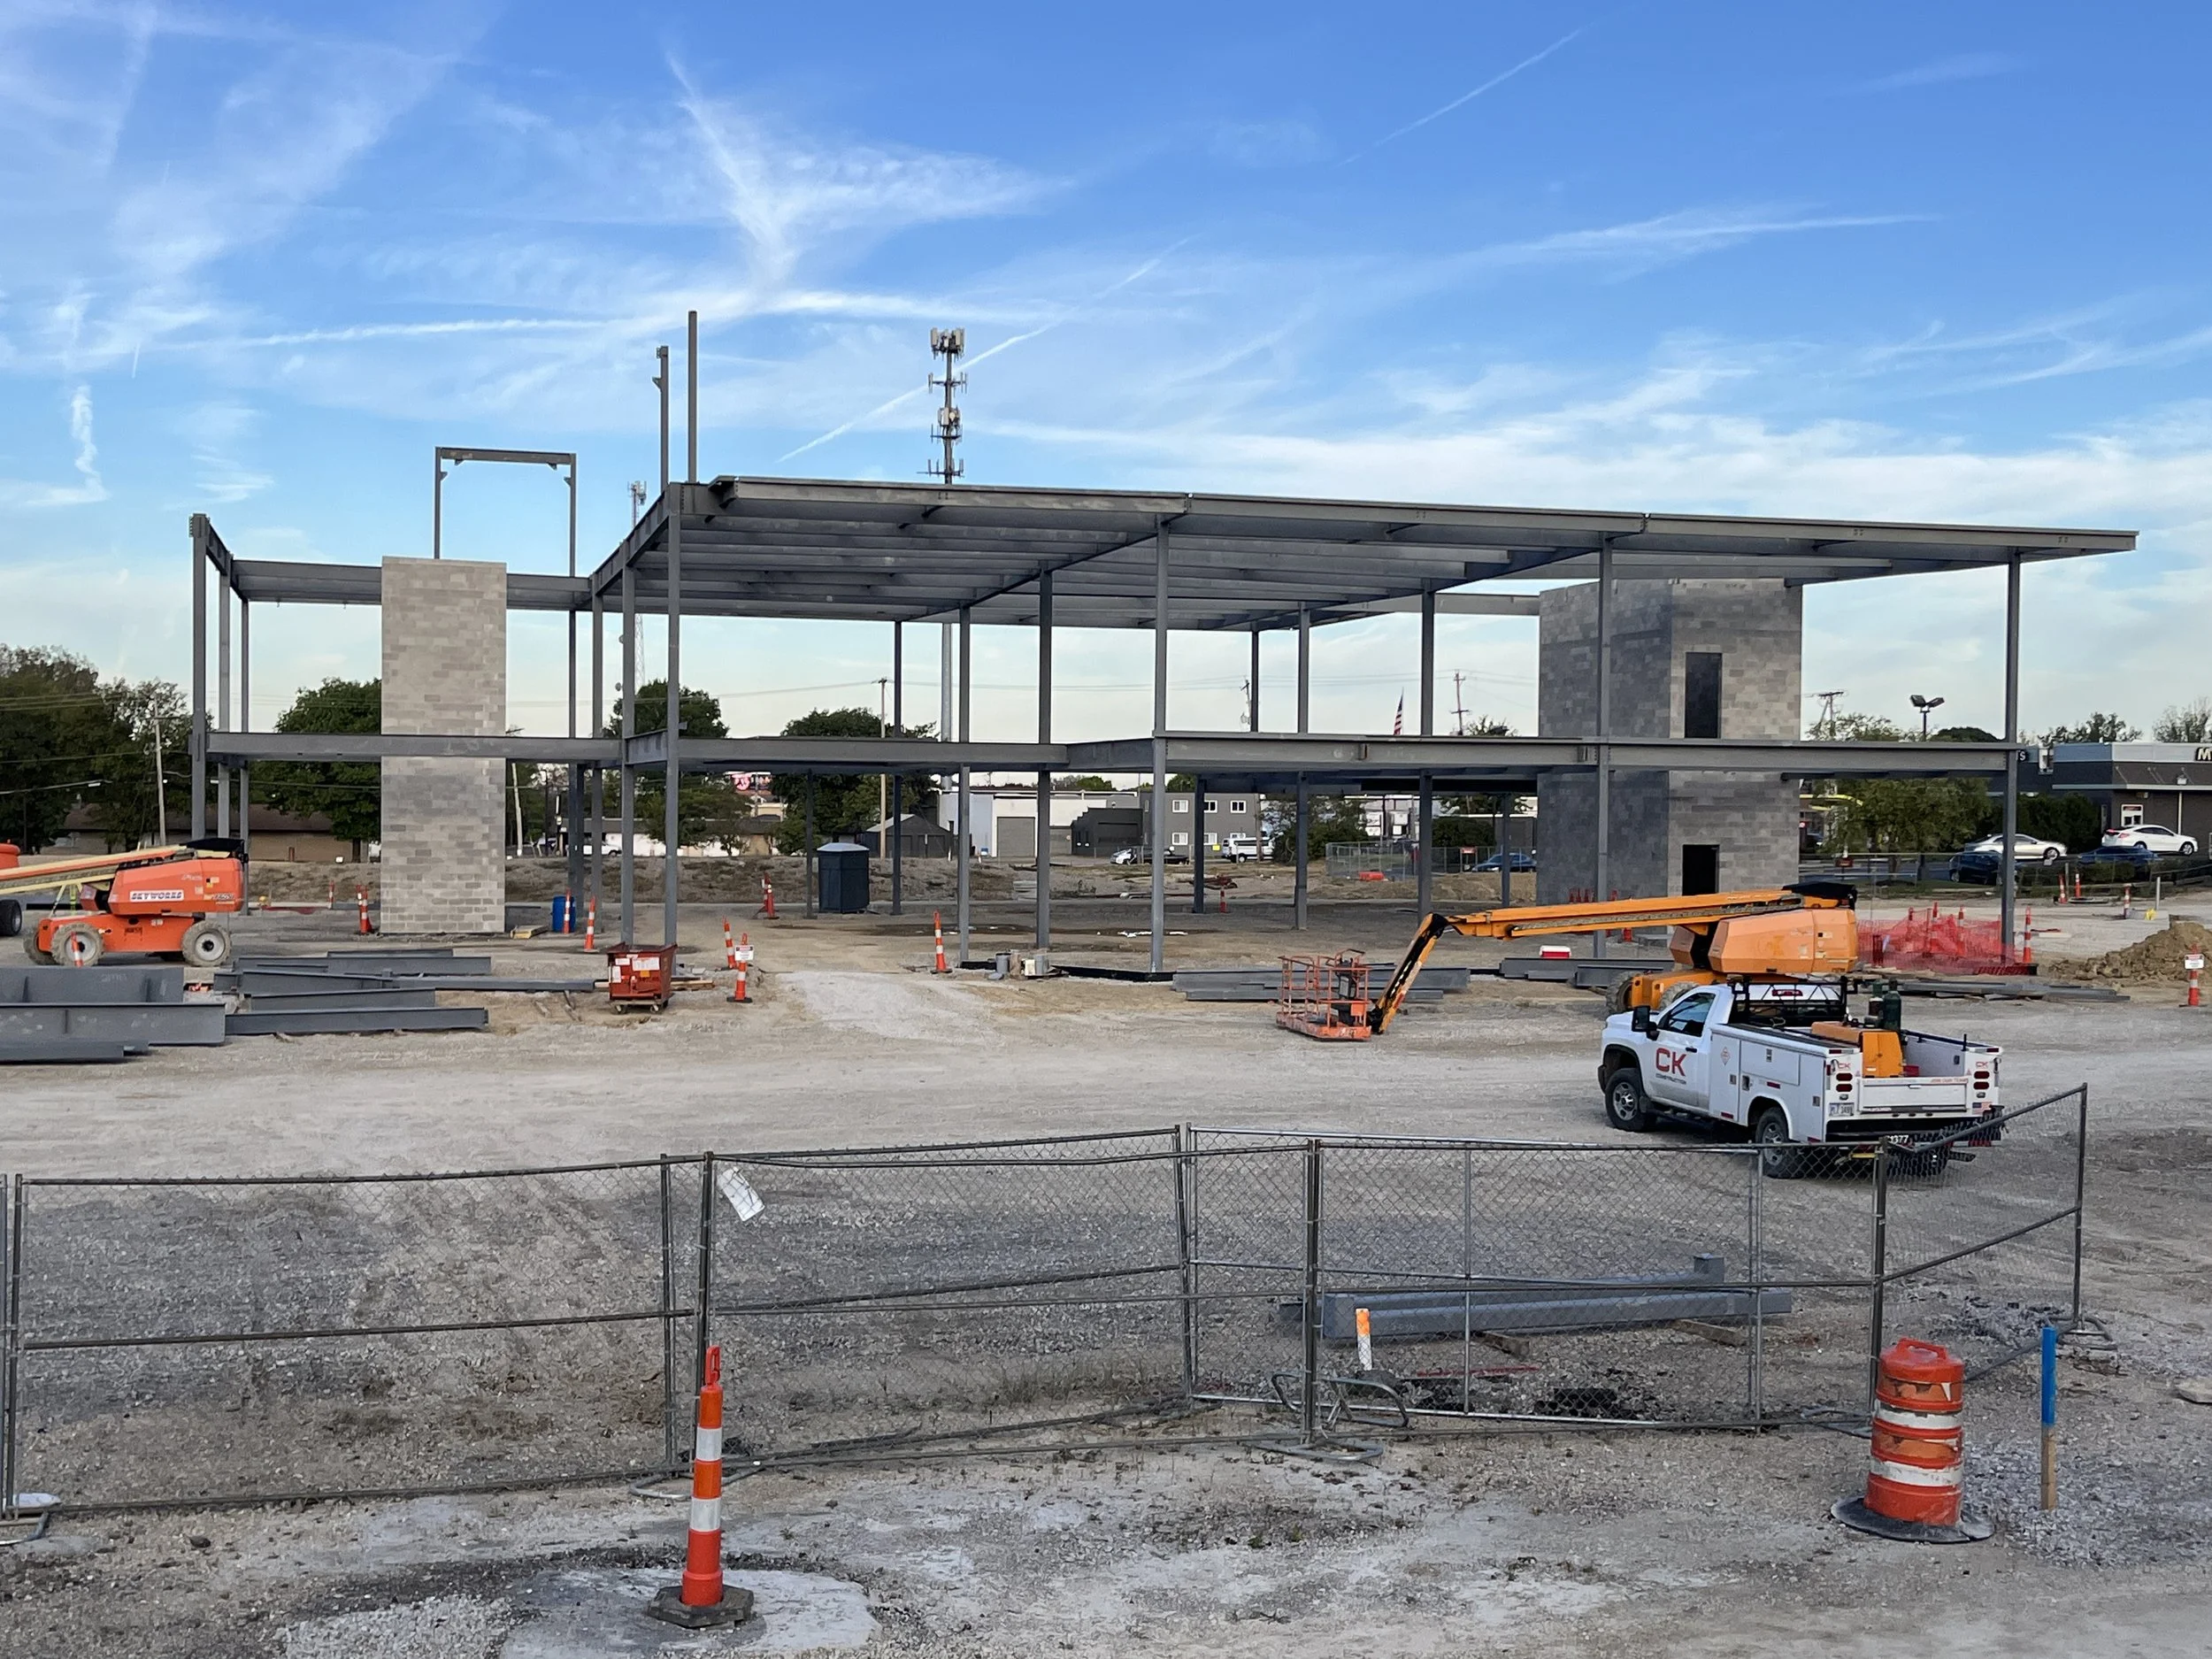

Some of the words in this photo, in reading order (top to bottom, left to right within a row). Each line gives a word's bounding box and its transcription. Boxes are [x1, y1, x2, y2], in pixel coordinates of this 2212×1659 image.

[2198, 748, 2212, 761] M
[131, 891, 182, 900] SKYWORKS
[1655, 1048, 1687, 1077] CK
